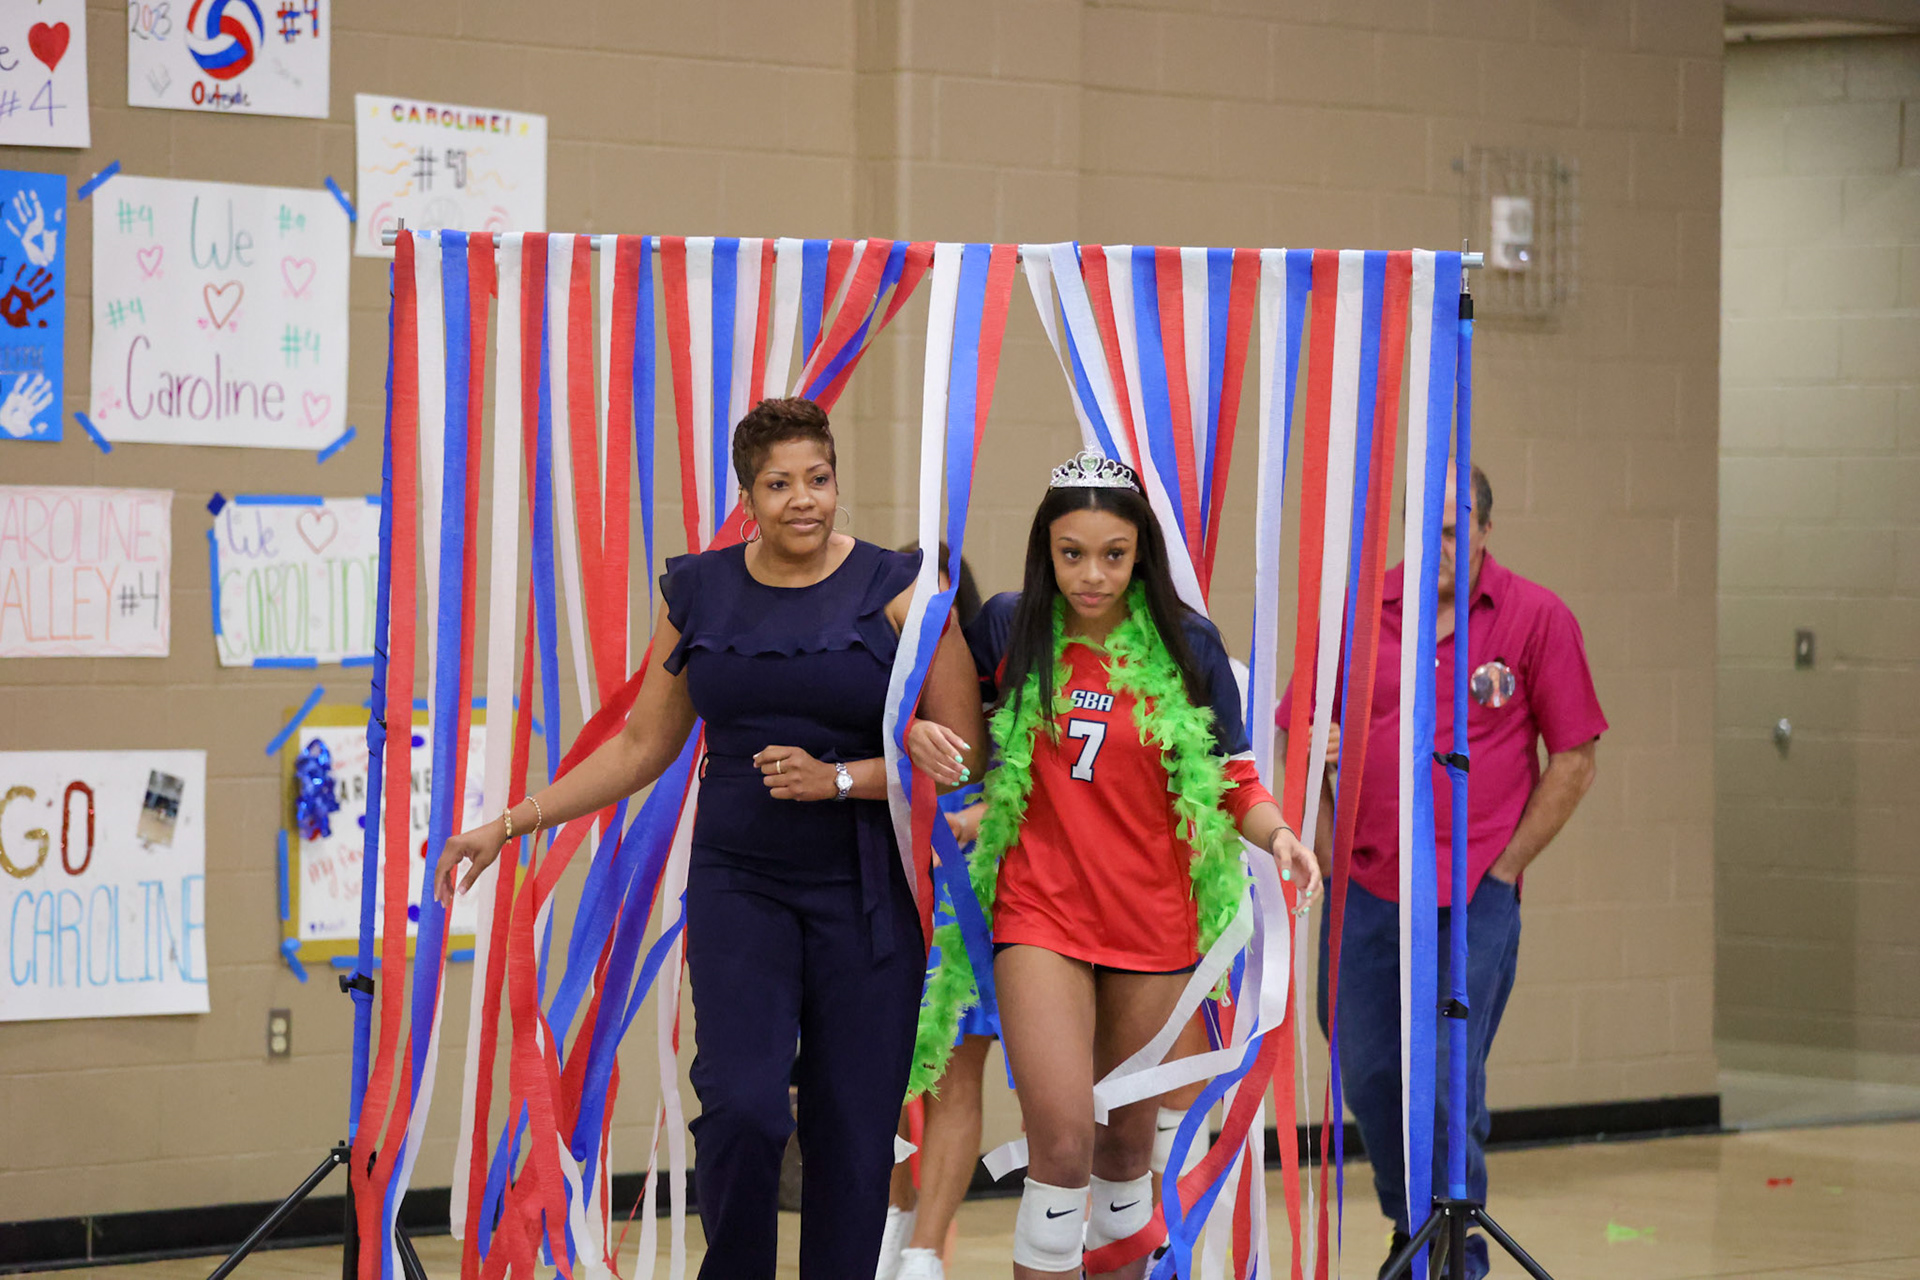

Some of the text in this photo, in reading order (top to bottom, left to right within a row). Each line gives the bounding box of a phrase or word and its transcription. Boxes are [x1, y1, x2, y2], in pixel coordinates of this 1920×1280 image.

[190, 195, 255, 271] We
[106, 297, 146, 330] #4
[126, 335, 286, 421] Caroline
[280, 323, 321, 369] #4
[225, 507, 280, 559] We
[117, 570, 161, 632] #4
[1070, 688, 1116, 713] SBA
[1067, 717, 1108, 783] 7
[0, 780, 95, 878] GO
[9, 874, 208, 989] CAROLINE
